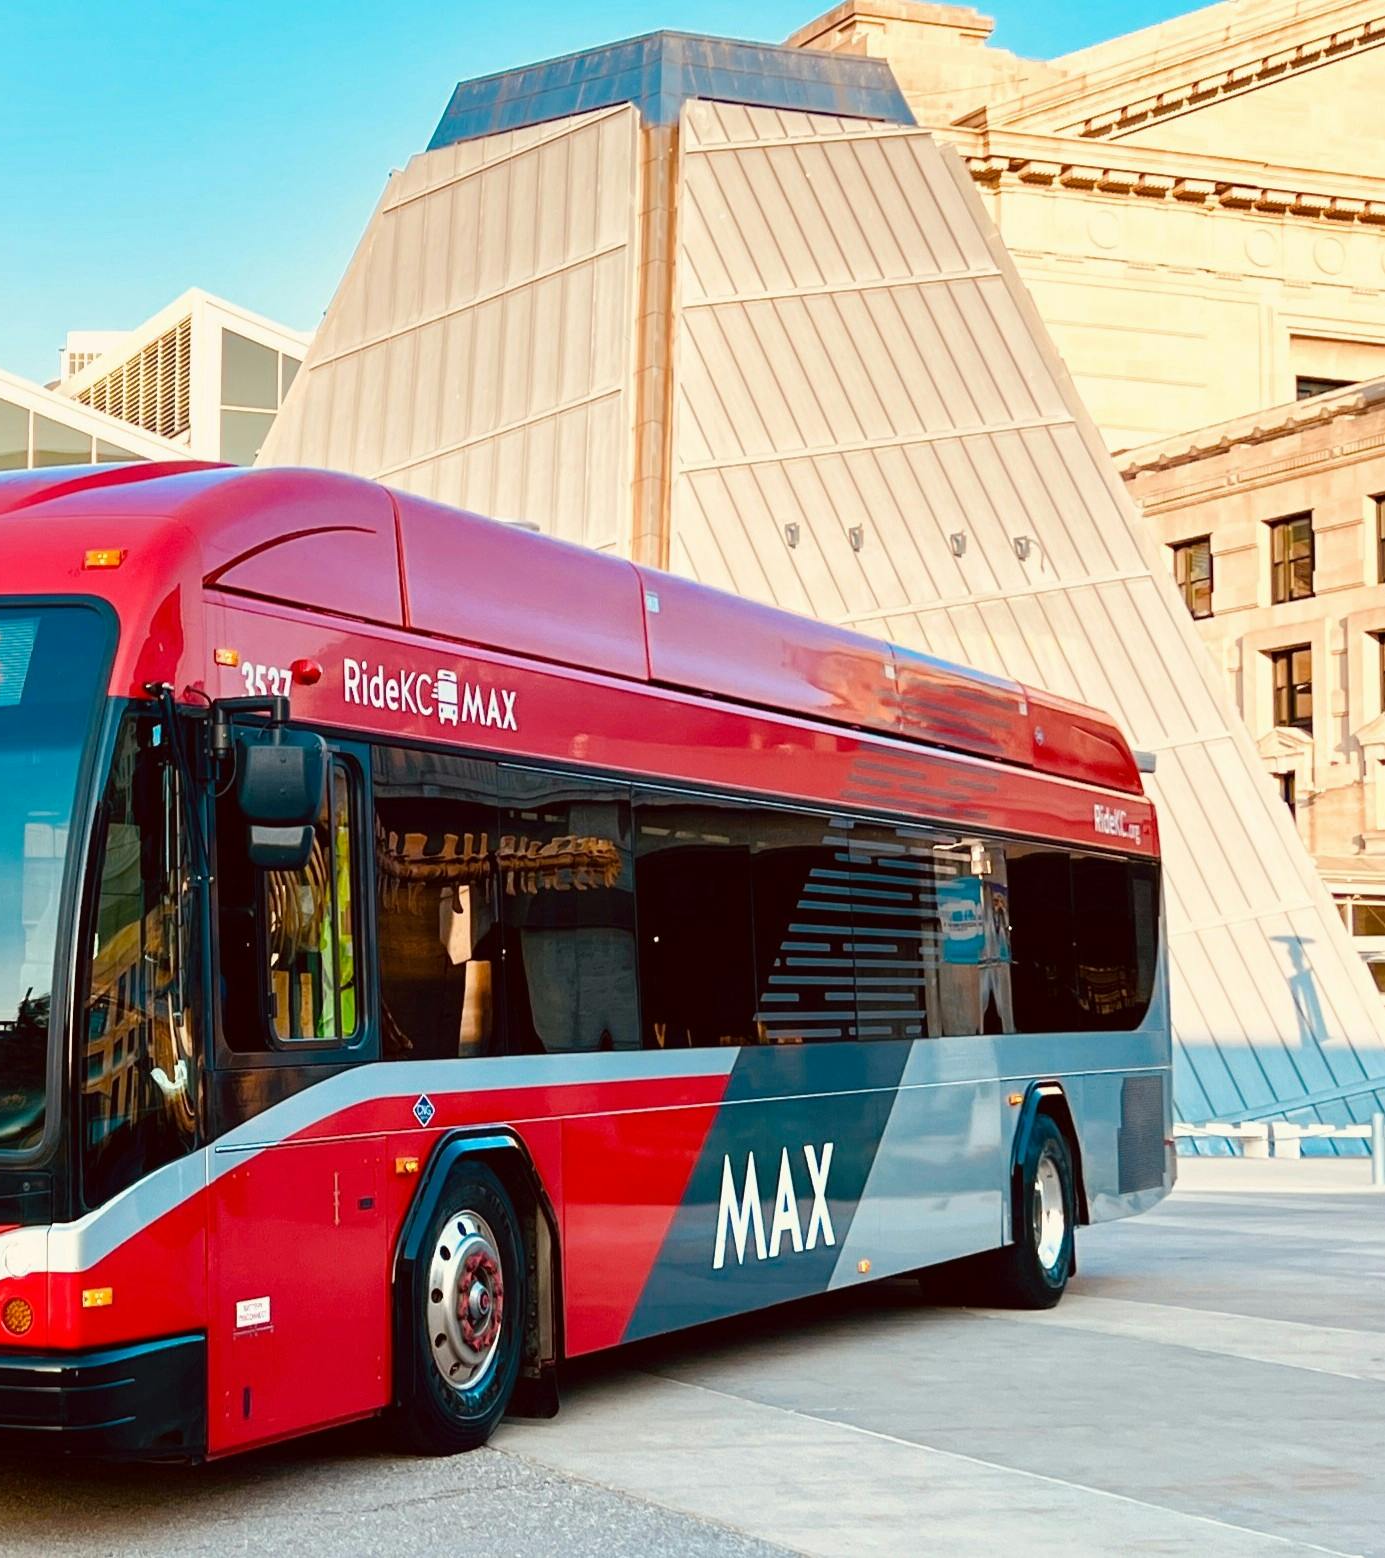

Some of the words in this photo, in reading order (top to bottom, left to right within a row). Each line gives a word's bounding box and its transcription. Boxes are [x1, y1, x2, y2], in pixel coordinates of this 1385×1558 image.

[241, 660, 293, 697] 3537
[343, 658, 434, 717] RideKC
[461, 682, 518, 731] MAX
[713, 1142, 836, 1269] MAX
